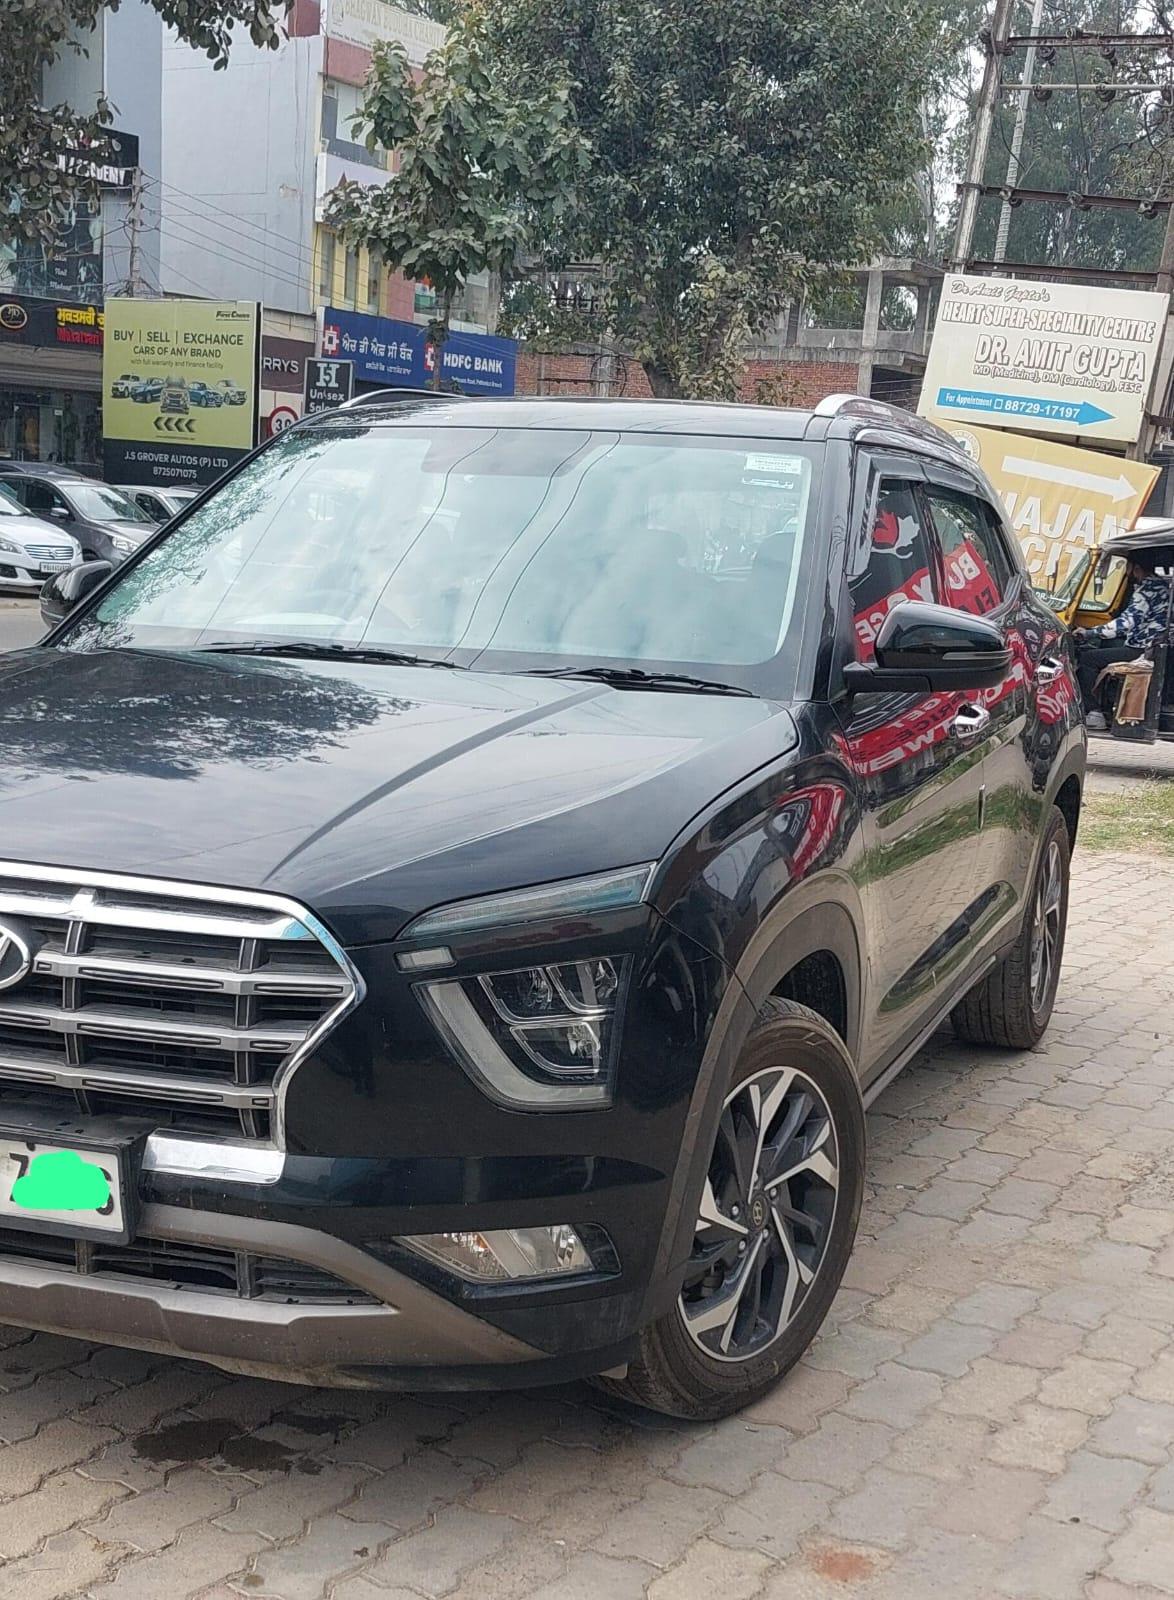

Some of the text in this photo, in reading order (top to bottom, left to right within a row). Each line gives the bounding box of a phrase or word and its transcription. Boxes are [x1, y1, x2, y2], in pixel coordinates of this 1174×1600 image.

[966, 282, 1003, 299] Amit
[1002, 285, 1051, 303] Gupta's
[942, 301, 985, 324] HEART
[1102, 317, 1157, 343] CENTRE
[114, 330, 244, 346] BUY SELL EXCHANGE
[359, 336, 369, 354] ਡੀ
[387, 341, 398, 359] ਸੀ
[133, 346, 222, 358] CARS OF ANY BRAND
[974, 334, 1147, 382] DR. AMIT GUPTA
[152, 360, 174, 368] warranty
[186, 360, 205, 368] finance
[206, 361, 224, 370] facility
[443, 352, 503, 374] HDFC BANK
[973, 365, 991, 377] MD
[1042, 373, 1060, 385] DM
[1118, 382, 1142, 394] FESC
[309, 388, 345, 401] Unisex
[946, 392, 1080, 419] For Appointment 88729-17197
[137, 452, 170, 463] GROVER
[170, 454, 198, 465] AUTOS
[199, 457, 212, 468] (P)
[212, 458, 229, 468] LTD
[153, 466, 197, 479] 8725071075
